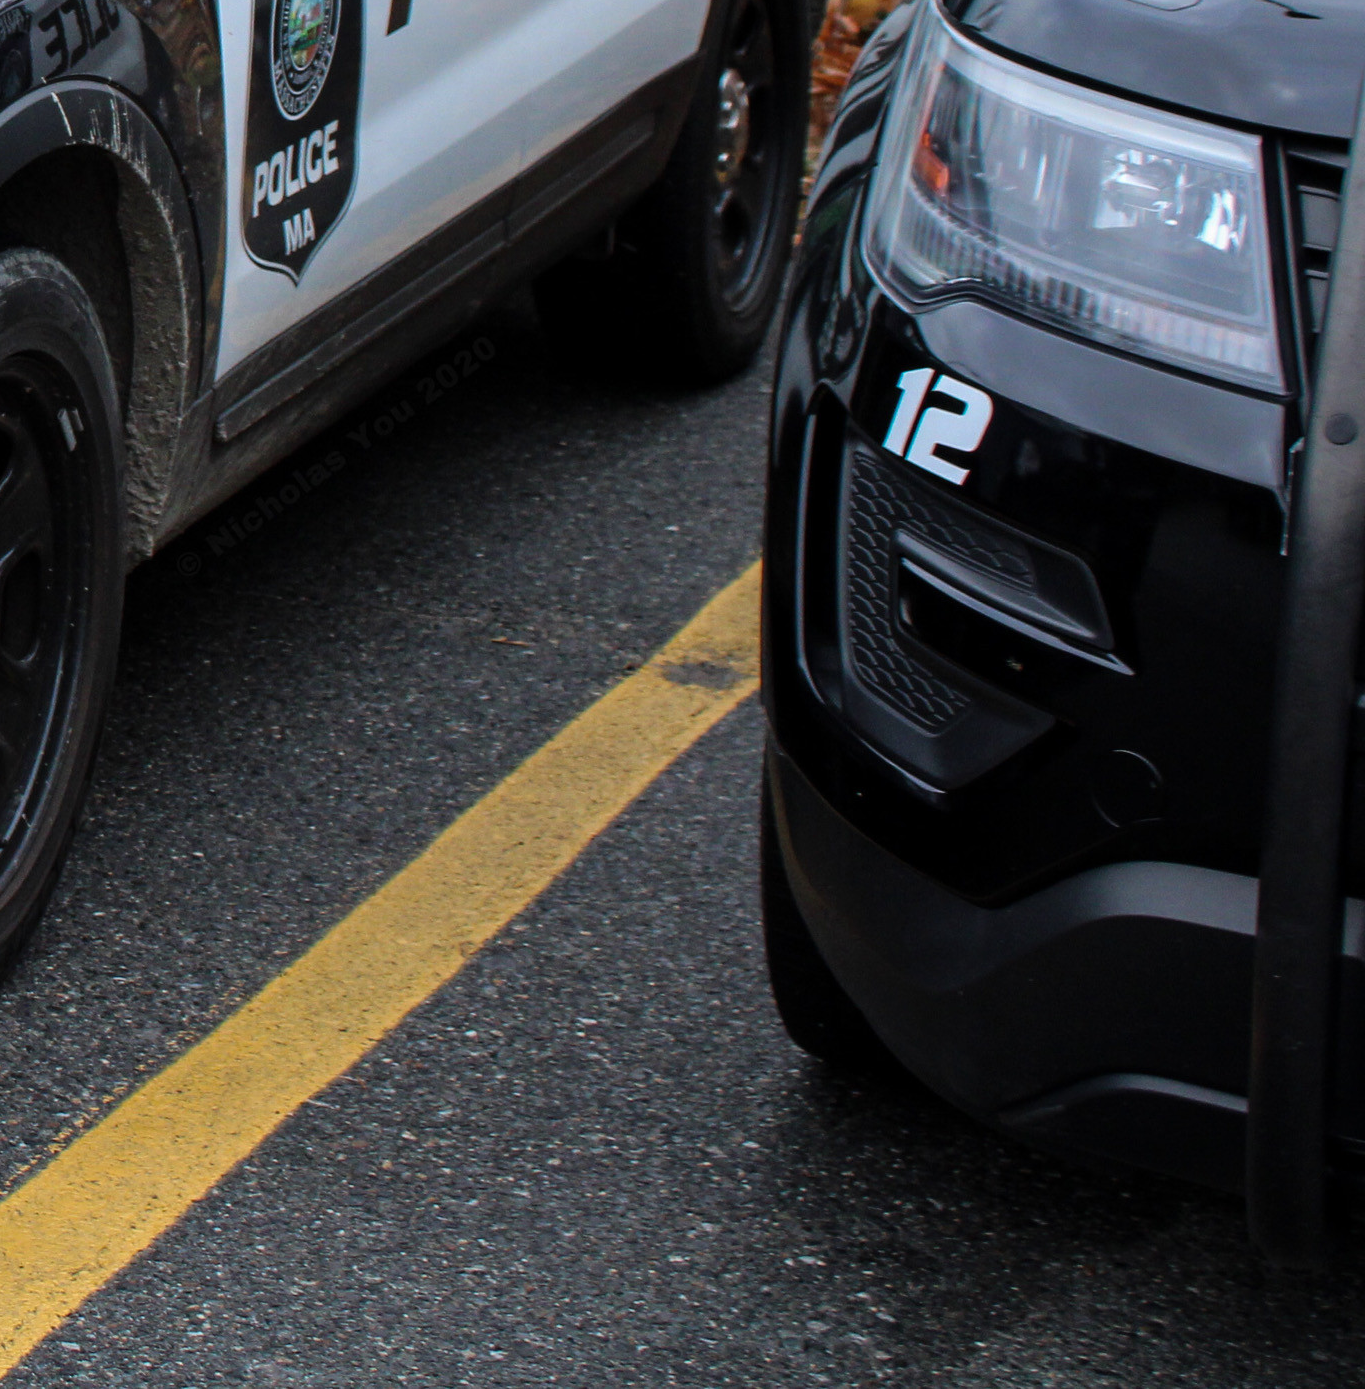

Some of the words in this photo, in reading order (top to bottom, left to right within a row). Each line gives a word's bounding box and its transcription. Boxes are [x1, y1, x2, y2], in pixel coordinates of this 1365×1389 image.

[252, 119, 340, 218] POLICE
[282, 208, 315, 256] MA
[881, 367, 994, 486] 12
